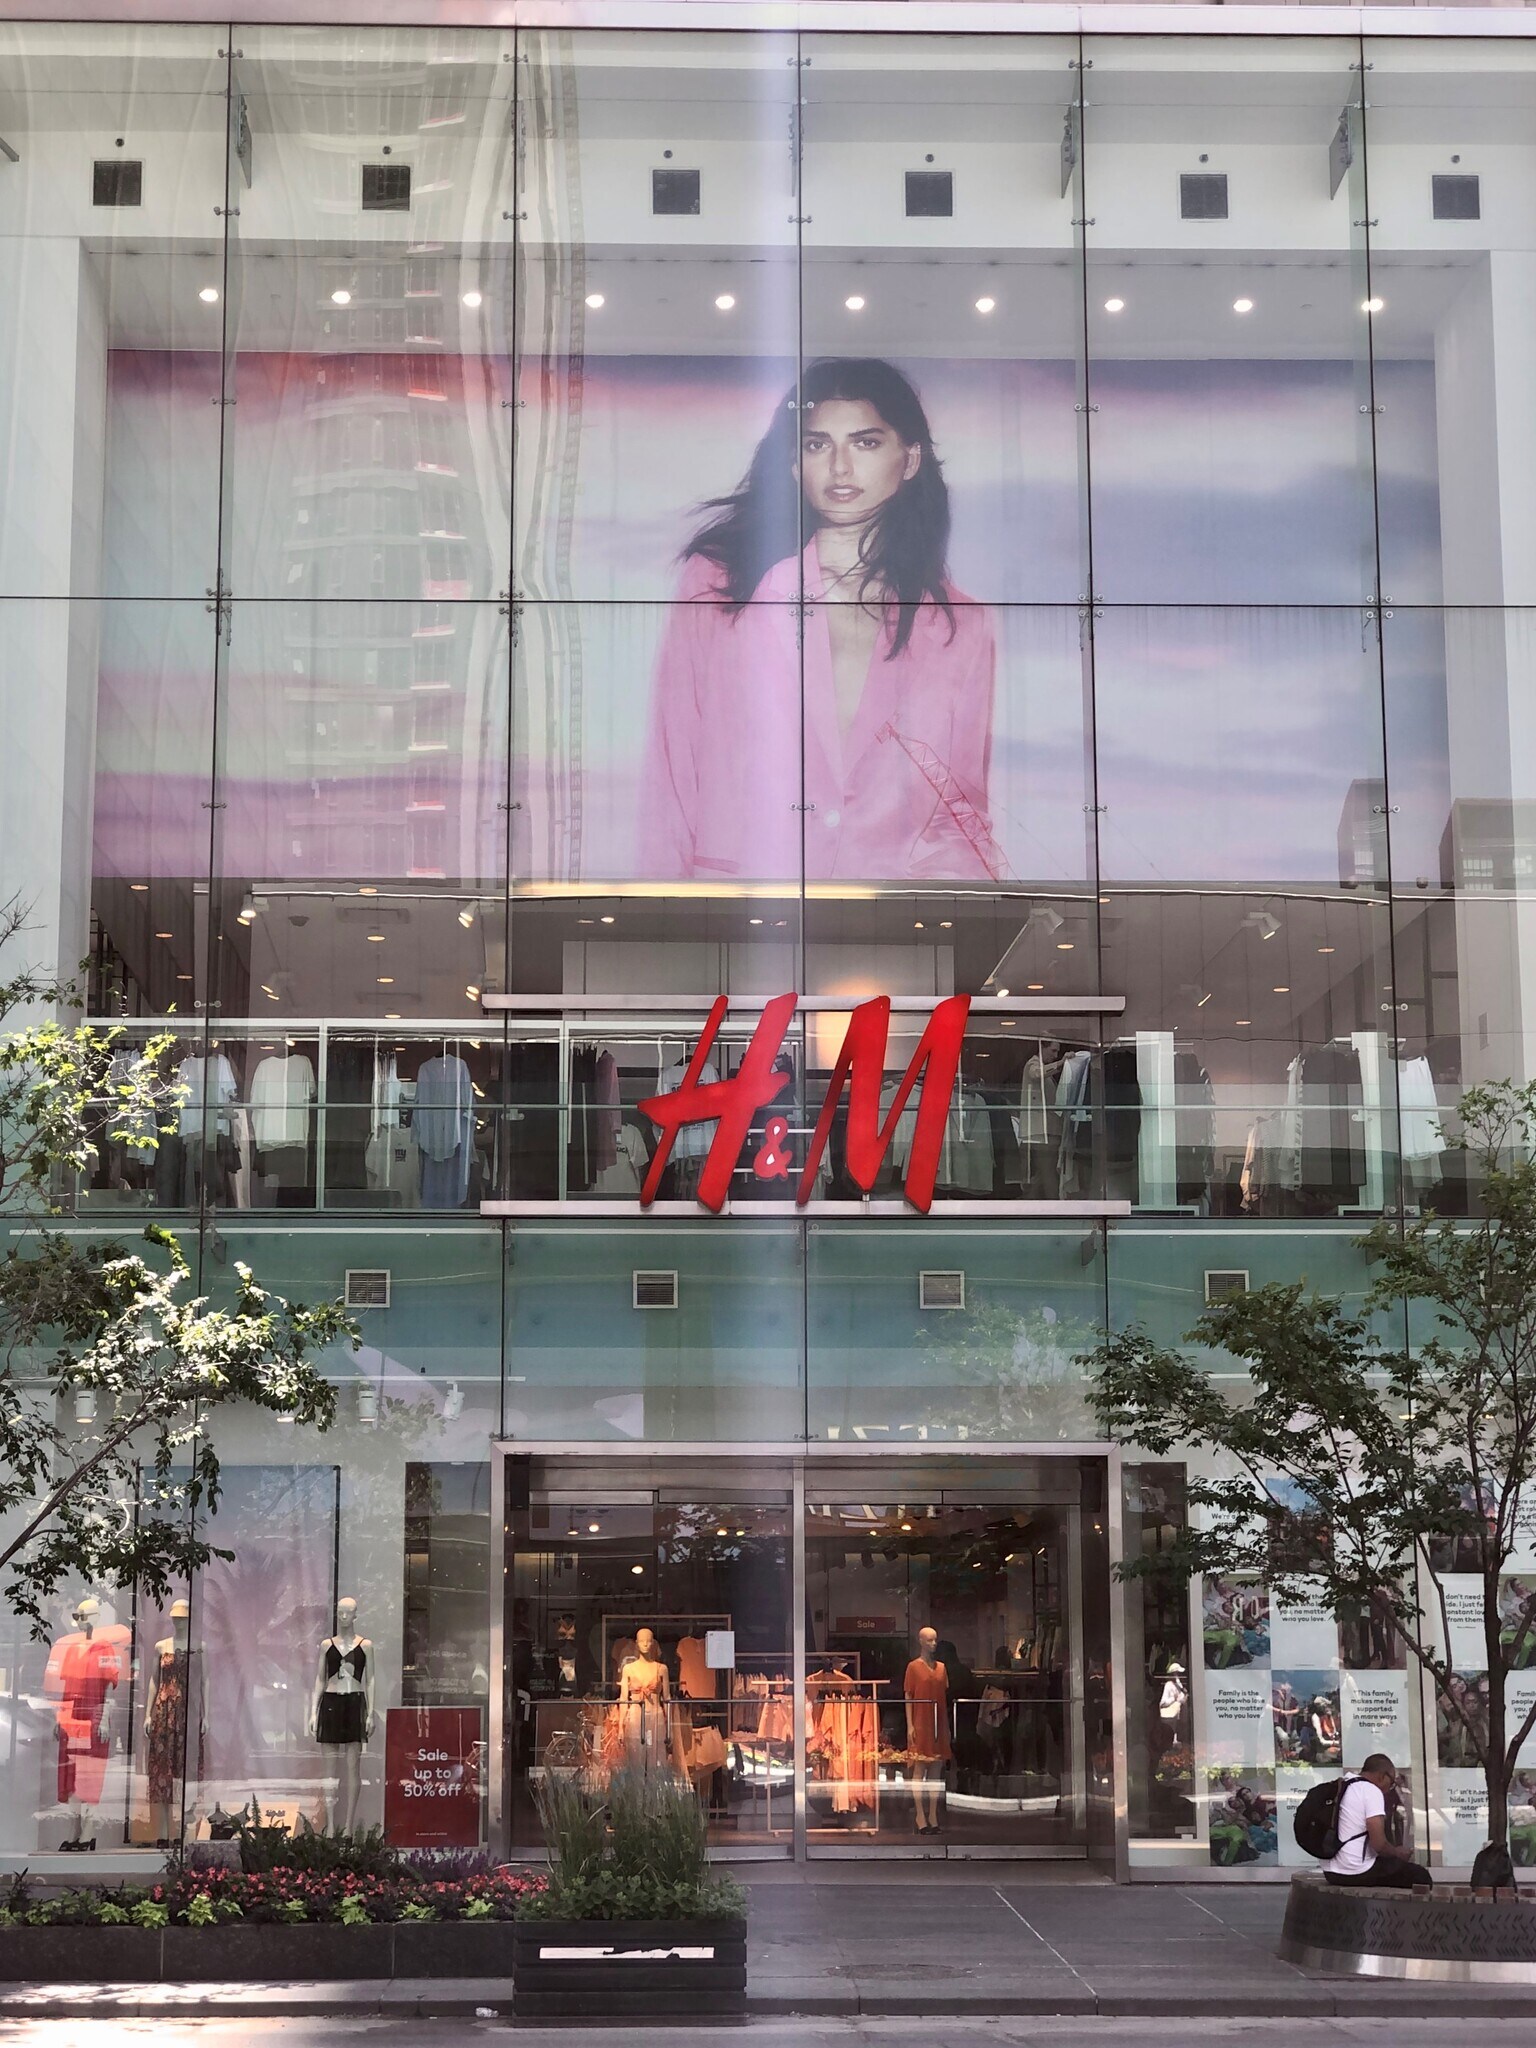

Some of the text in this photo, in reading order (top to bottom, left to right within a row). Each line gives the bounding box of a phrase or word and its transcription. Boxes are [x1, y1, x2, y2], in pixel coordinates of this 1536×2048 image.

[637, 992, 971, 1214] H&M
[1462, 1601, 1476, 1609] just
[857, 1620, 875, 1628] Sale
[417, 1748, 449, 1761] Sale
[414, 1767, 452, 1782] up to
[403, 1783, 461, 1797] 50% off
